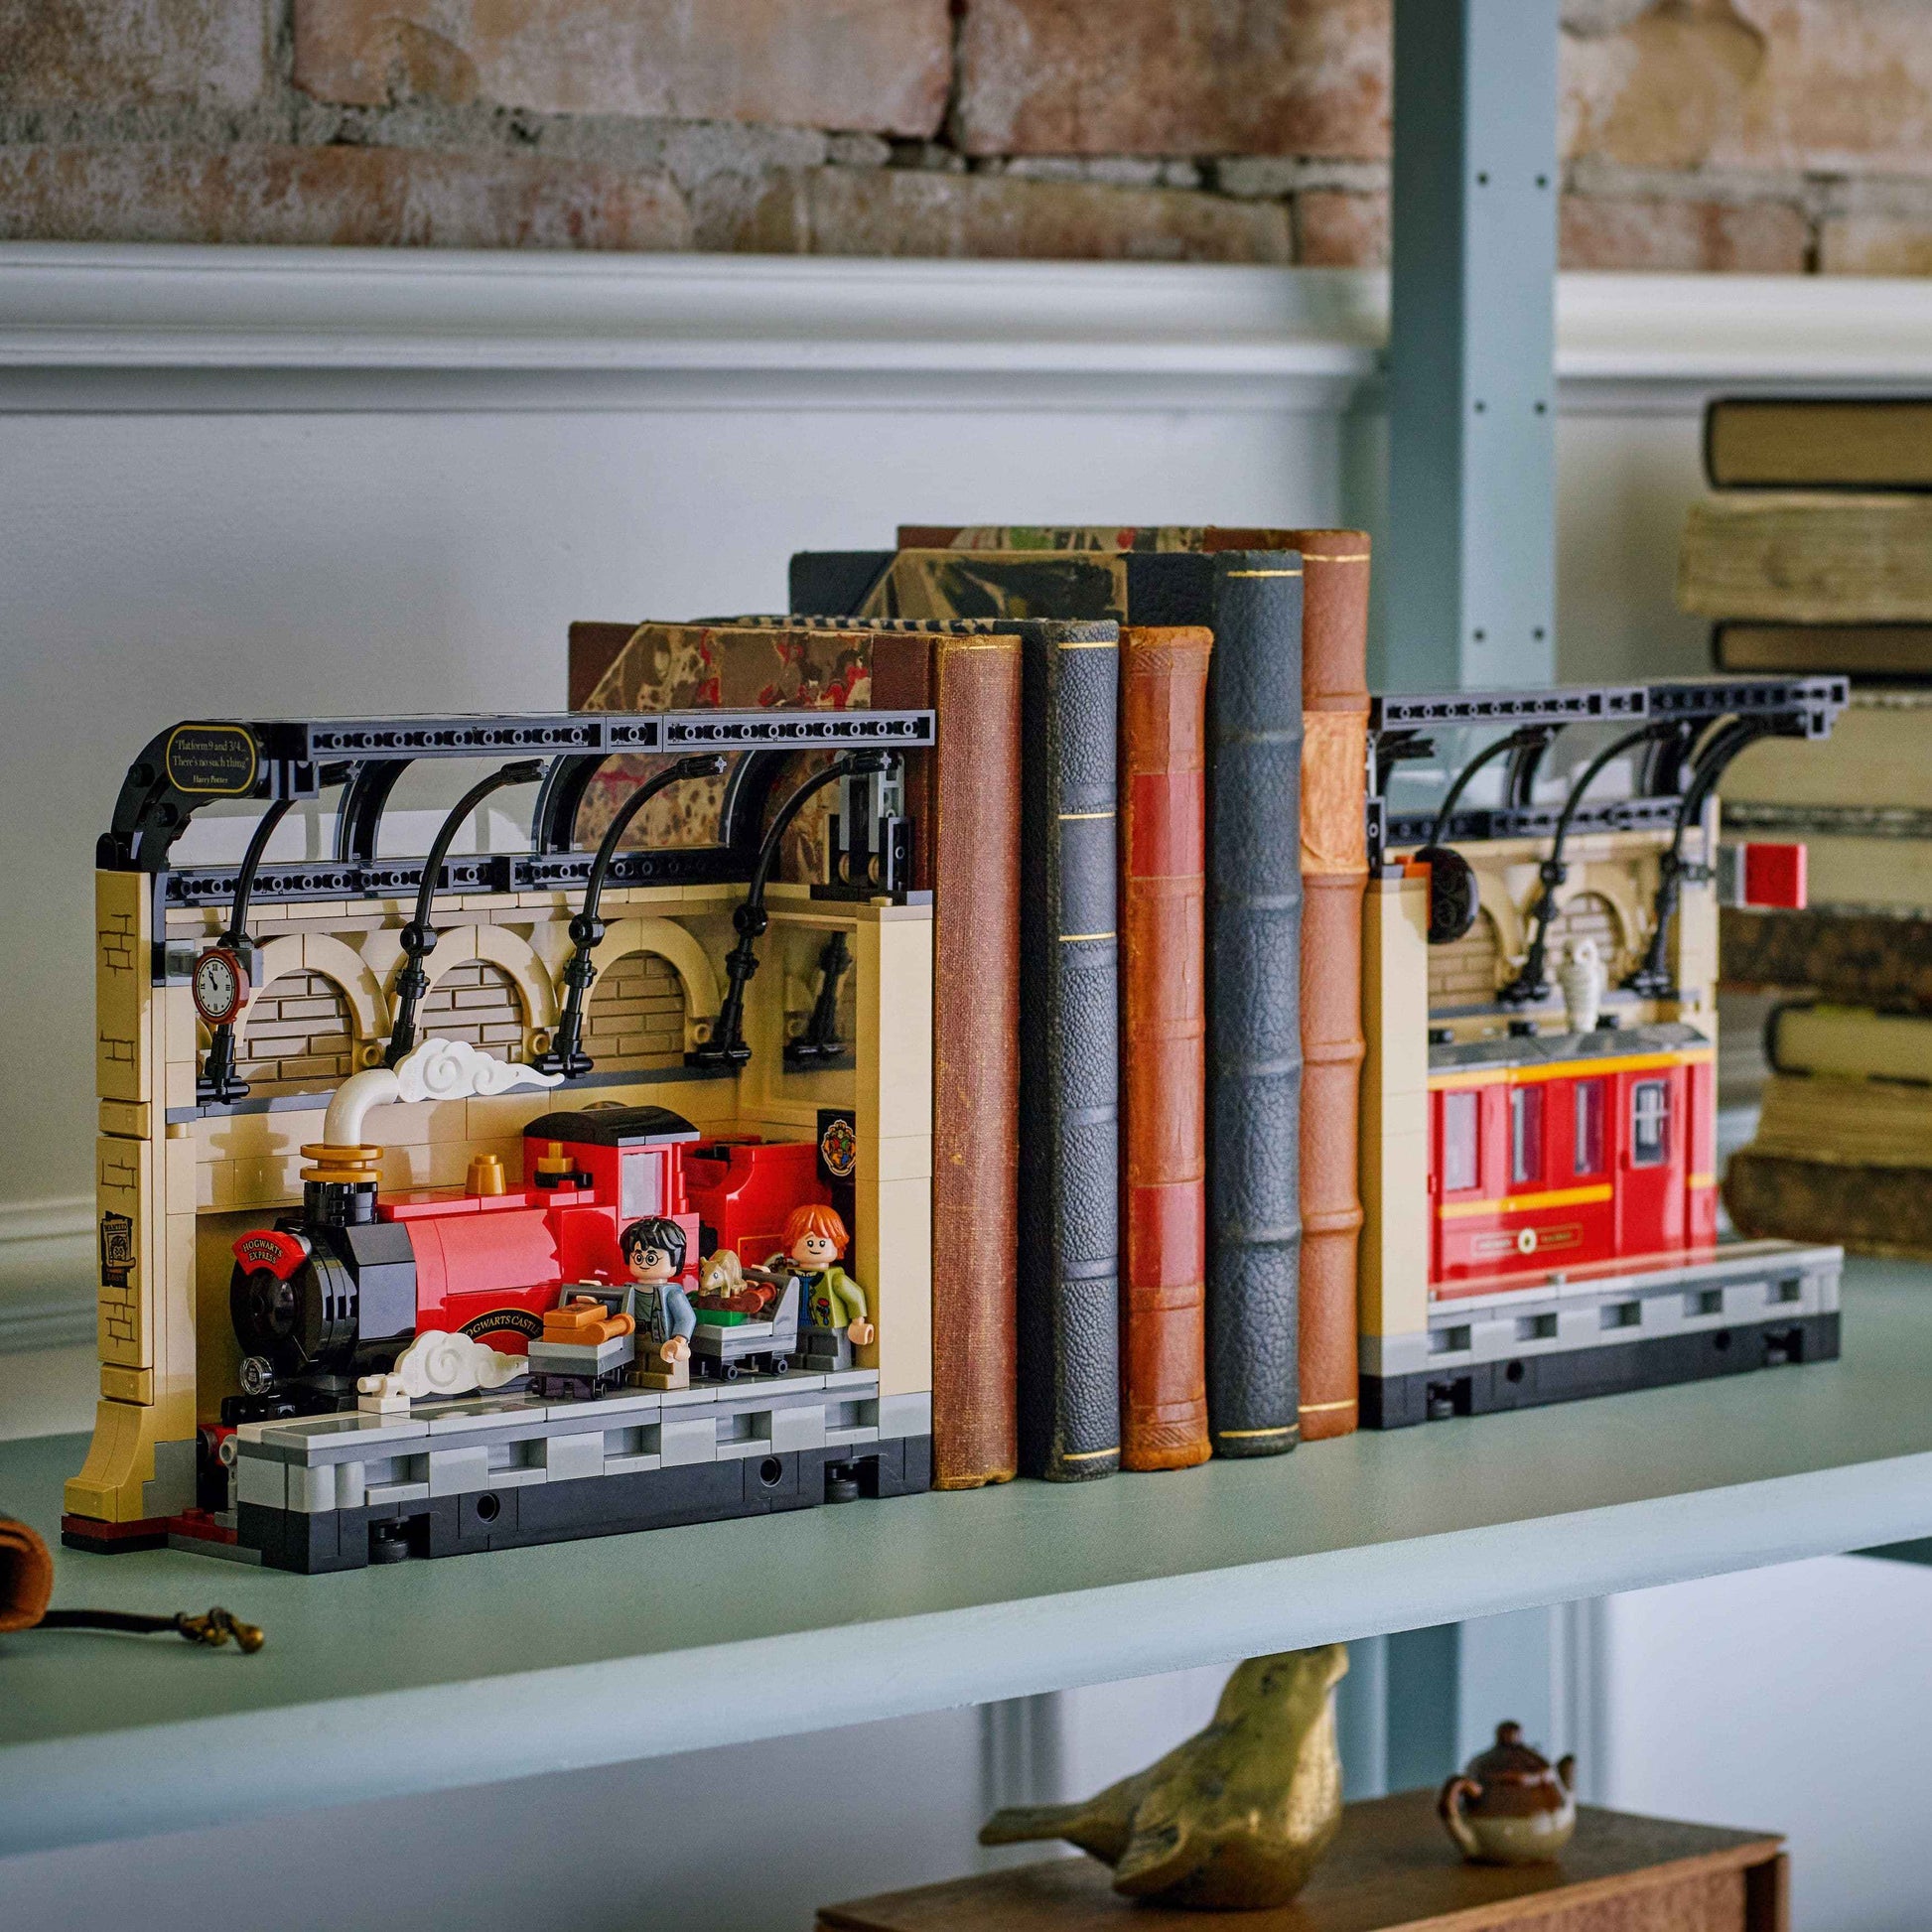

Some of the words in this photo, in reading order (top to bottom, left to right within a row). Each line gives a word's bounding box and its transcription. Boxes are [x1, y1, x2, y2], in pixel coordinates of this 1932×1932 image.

[193, 774, 209, 784] Harry
[210, 775, 228, 784] Potter
[242, 1238, 284, 1259] HOGWARTS
[248, 1250, 277, 1265] EXPRESS
[465, 1314, 512, 1337] OGWARTS
